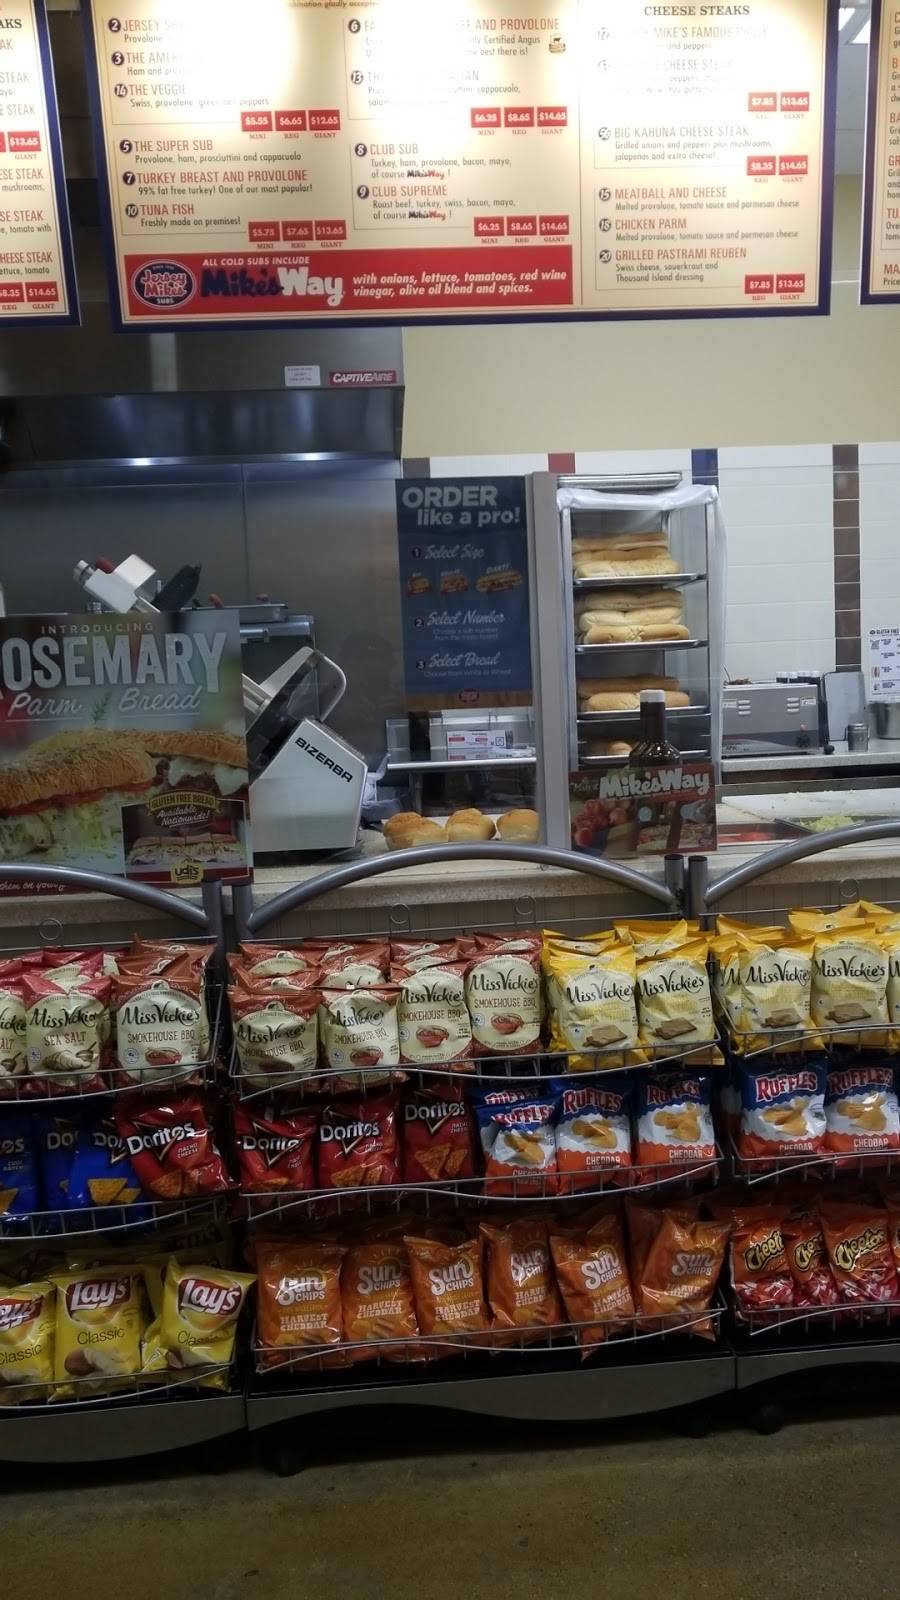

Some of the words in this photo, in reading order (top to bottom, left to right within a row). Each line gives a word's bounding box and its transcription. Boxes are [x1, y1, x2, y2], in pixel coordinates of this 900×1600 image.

[644, 6, 696, 16] CHEESE
[700, 5, 750, 16] STEAKS
[123, 20, 160, 32] JERSEY
[500, 19, 559, 30] PROVOLONE
[518, 35, 540, 45] Angus
[126, 52, 145, 64] THE
[128, 84, 148, 96] THE
[312, 116, 338, 125] $12.65
[635, 127, 676, 137] KAHUNA
[135, 141, 153, 151] THE
[156, 141, 190, 151] SUPER
[193, 140, 213, 150] SUB
[370, 144, 395, 154] CLUB
[399, 144, 419, 154] SUB
[178, 154, 197, 164] ham,
[243, 153, 257, 162] and
[371, 158, 397, 168] Turkey,
[400, 158, 419, 167] ham,
[16, 168, 43, 180] STEAK
[137, 172, 175, 183] TURKEY
[180, 171, 218, 183] BREAST
[223, 171, 244, 182] AND
[249, 170, 307, 181] PROVOLONE
[157, 186, 168, 195] fat
[170, 186, 186, 195] free
[218, 185, 234, 194] One
[261, 184, 279, 193] most
[372, 187, 397, 197] CLUB
[401, 186, 448, 196] SUPREME
[615, 187, 666, 199] MEATBALL
[669, 187, 689, 198] AND
[693, 187, 727, 198] CHEESE
[140, 204, 169, 215] TUNA
[172, 204, 194, 214] FISH
[615, 202, 639, 211] Melted
[680, 201, 703, 210] tomato
[14, 210, 43, 221] STEAK
[10, 225, 35, 233] tomato
[37, 223, 51, 232] with
[141, 217, 167, 227] Freshly
[170, 217, 191, 226] made
[478, 222, 500, 232] $6.25
[511, 222, 533, 231] $8.65
[541, 222, 567, 231] $14.65
[615, 219, 655, 230] CHICKEN
[658, 218, 687, 229] PARM
[26, 251, 53, 263] STEAK
[615, 250, 654, 261] GRILLED
[657, 249, 707, 260] PASTRAMI
[710, 248, 747, 259] REUBEN
[203, 258, 218, 266] ALL
[221, 258, 243, 266] COLD
[247, 257, 269, 265] SUBS
[272, 256, 309, 265] INCLUDE
[616, 263, 634, 271] Swiss
[636, 263, 661, 272] cheese,
[705, 261, 719, 270] and
[25, 266, 50, 275] tomato
[143, 269, 187, 283] Jersey
[353, 273, 377, 284] with
[381, 273, 418, 284] onions,
[422, 272, 460, 283] lettuce,
[464, 270, 517, 282] tomatoes,
[520, 269, 538, 280] red
[541, 270, 566, 280] wine
[616, 274, 649, 282] Thousand
[675, 273, 704, 283] dressing
[144, 281, 187, 297] Mike's
[354, 287, 396, 297] vinegar,
[400, 285, 425, 295] olive
[429, 284, 442, 294] oil
[444, 283, 473, 294] blend
[476, 283, 495, 293] and
[498, 281, 533, 295] spices.
[333, 373, 393, 383] CAPTIVEAIRE
[402, 485, 497, 508] ORDER
[418, 508, 454, 526] like
[460, 511, 471, 524] a
[478, 507, 520, 527] pro!
[425, 545, 459, 559] Select
[461, 544, 484, 559] Size
[427, 611, 461, 625] Select
[463, 609, 504, 625] Number
[41, 622, 153, 634] INTRODUCING
[2, 632, 226, 692] OSEMARY
[429, 653, 463, 668] Select
[465, 651, 501, 667] Bread
[7, 692, 83, 717] Parm
[118, 686, 203, 712] Bread
[295, 736, 353, 783] BIZERBA
[474, 998, 520, 1009] SMOKEHOUSE
[522, 997, 537, 1008] BBQ
[400, 1010, 445, 1022] SMOKEHOUSE
[448, 1010, 463, 1019] BBQ
[44, 1034, 62, 1046] SEA
[64, 1031, 87, 1044] SALT
[127, 1031, 178, 1043] SMOKEHOUSE
[180, 1029, 196, 1041] BBQ
[289, 1040, 306, 1052] BBQ
[756, 1072, 817, 1102] RUFFLES
[829, 1068, 893, 1094] RUFFLES
[564, 1088, 623, 1114] RUFFLES
[405, 1101, 465, 1121] Doritos
[492, 1105, 554, 1125] RUFFLES
[320, 1120, 380, 1141] Doritos
[126, 1122, 196, 1155] Doritos
[854, 1138, 888, 1147] CHEDDAR
[669, 1149, 703, 1159] CHEDDAR
[586, 1156, 620, 1166] CHEDDAR
[835, 1228, 886, 1272] Cheetos
[672, 1252, 714, 1276] Sun
[581, 1251, 619, 1290] Sun
[600, 1267, 622, 1283] CHIPS
[686, 1266, 712, 1276] CHIPS
[357, 1264, 400, 1295] Sun
[429, 1260, 473, 1296] Sun
[277, 1275, 327, 1306] Sun
[374, 1280, 400, 1291] CHIPS
[445, 1279, 474, 1292] CHIPS
[71, 1278, 128, 1311] Lay's
[181, 1279, 241, 1315] Lay's
[296, 1290, 325, 1302] CHIPS
[593, 1285, 630, 1308] HARVEST
[358, 1300, 402, 1312] HARVEST
[435, 1300, 480, 1314] HARVEST
[281, 1313, 328, 1324] HARVEST
[357, 1307, 402, 1318] CHEDDAR
[435, 1307, 480, 1322] CHEDDAR
[280, 1321, 327, 1331] CHEDDAR
[77, 1327, 125, 1345] Classic
